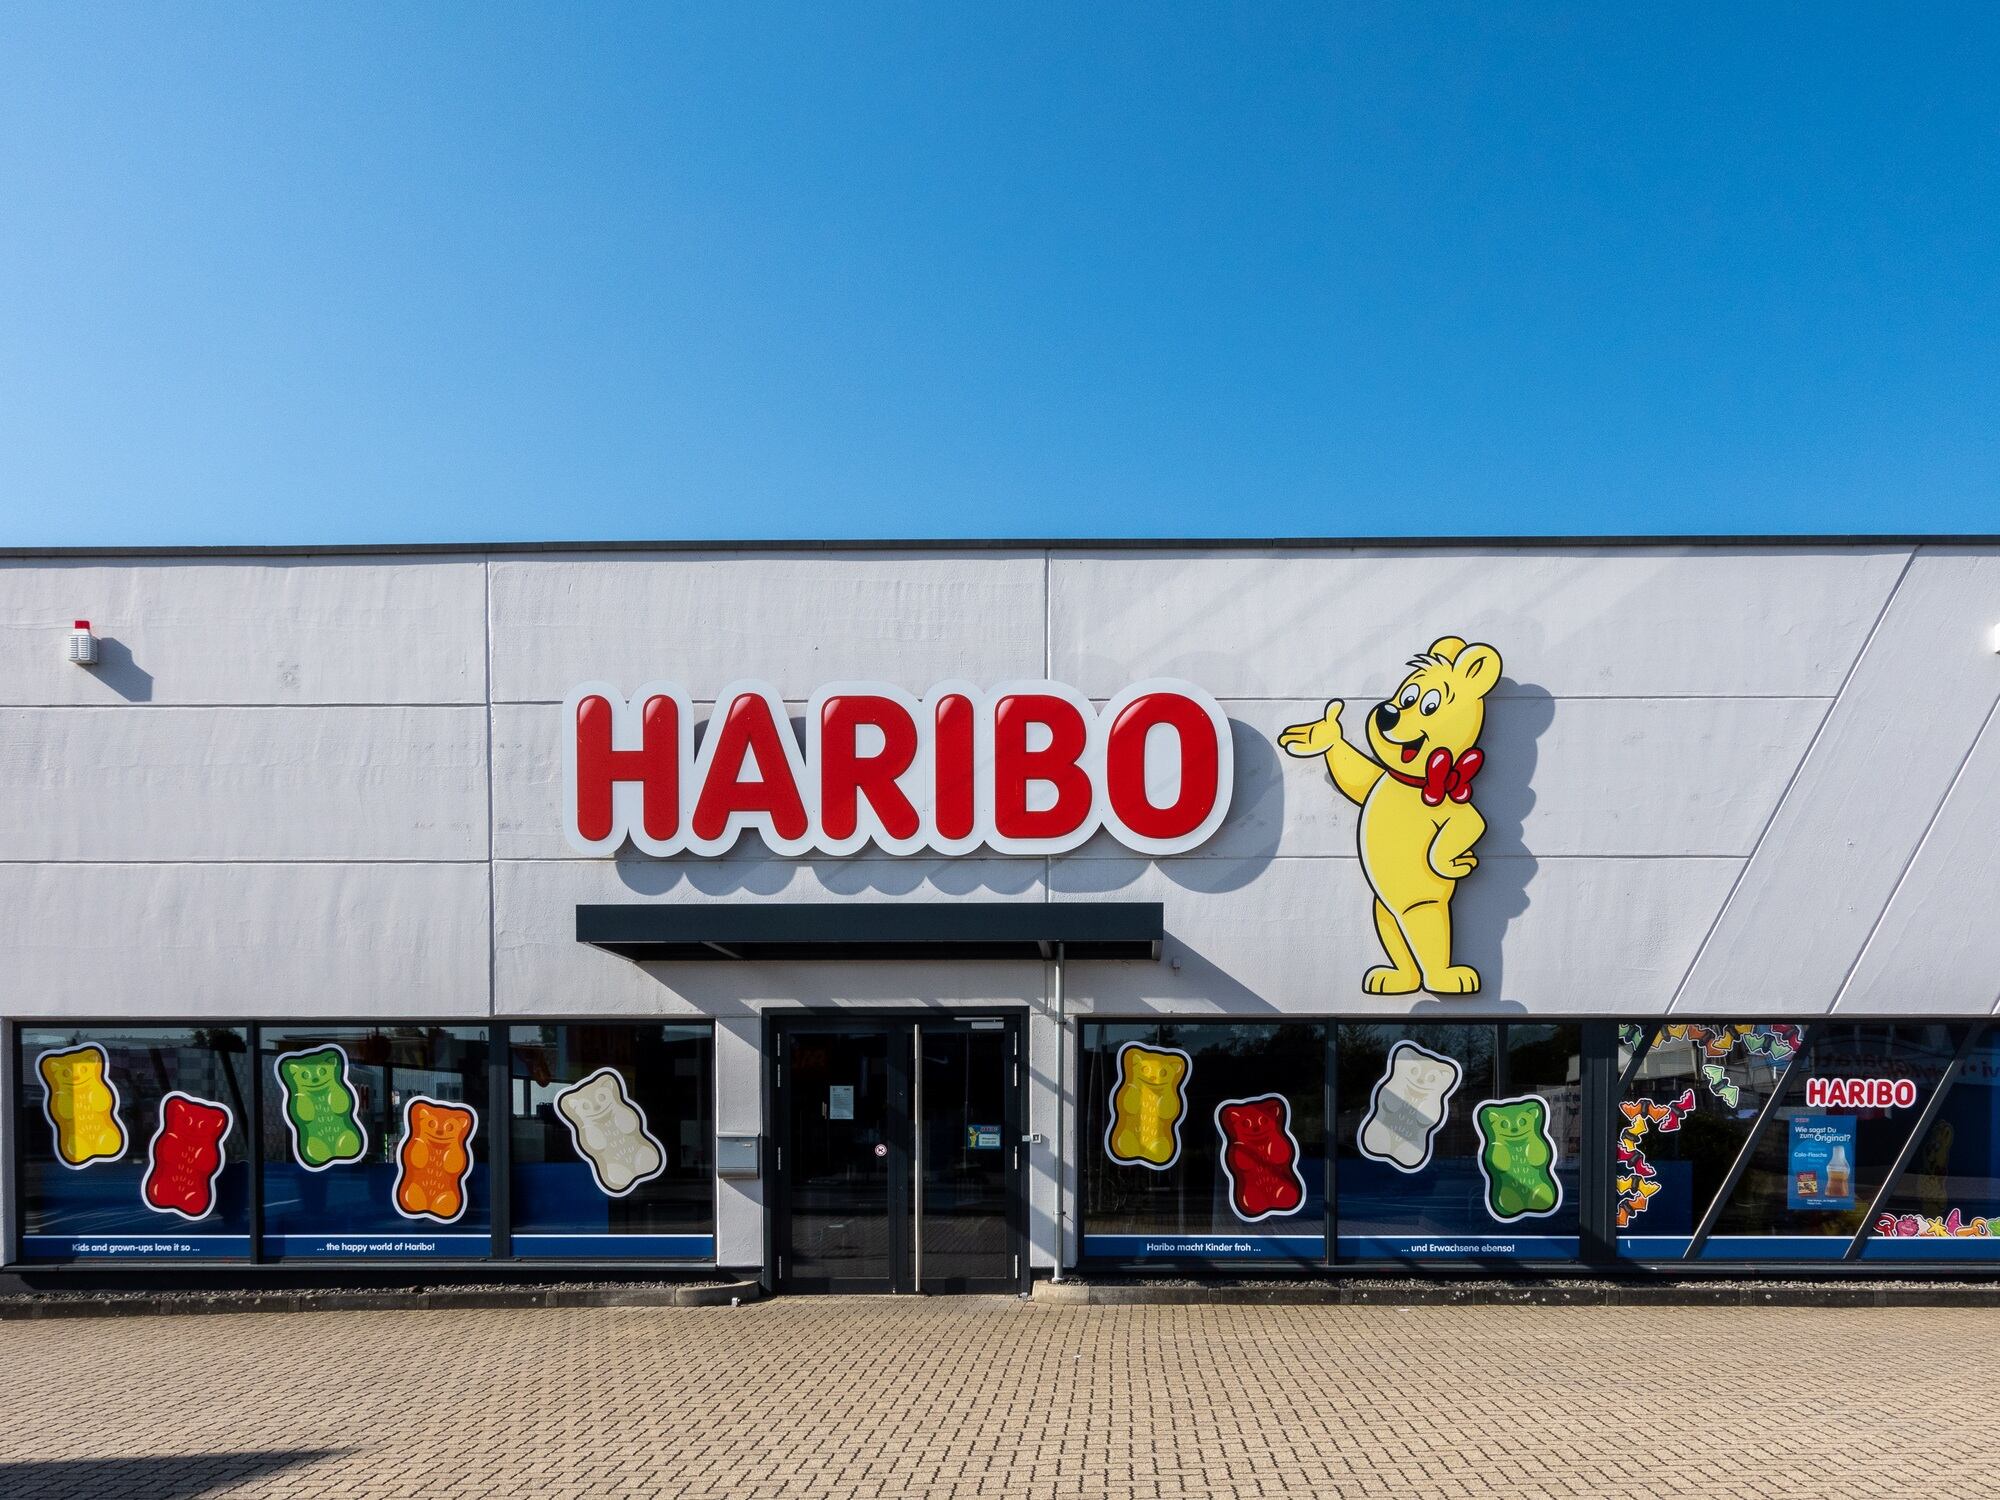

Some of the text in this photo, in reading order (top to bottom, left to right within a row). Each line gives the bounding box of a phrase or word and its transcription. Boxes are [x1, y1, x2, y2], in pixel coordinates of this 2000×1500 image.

[574, 691, 1220, 843] HARIBO
[1807, 1079, 1915, 1106] HARIBO
[1809, 1126, 1826, 1134] sagst
[1814, 1134, 1851, 1143] Original?
[72, 1243, 90, 1252] Kids
[91, 1243, 108, 1252] and
[109, 1244, 153, 1254] grown-ups
[154, 1243, 172, 1252] love
[173, 1243, 180, 1252] it
[180, 1244, 191, 1252] so
[326, 1242, 340, 1251] the
[341, 1242, 368, 1253] happy
[369, 1242, 393, 1251] world
[394, 1242, 404, 1251] of
[404, 1242, 435, 1251] Haribo!
[1146, 1242, 1175, 1251] Haribo
[1177, 1242, 1204, 1252] macht
[1205, 1242, 1233, 1252] Kinder
[1234, 1242, 1252, 1252] froh
[1411, 1243, 1428, 1252] und
[1429, 1243, 1480, 1252] Erwachsene
[1481, 1243, 1515, 1252] ebenso!
